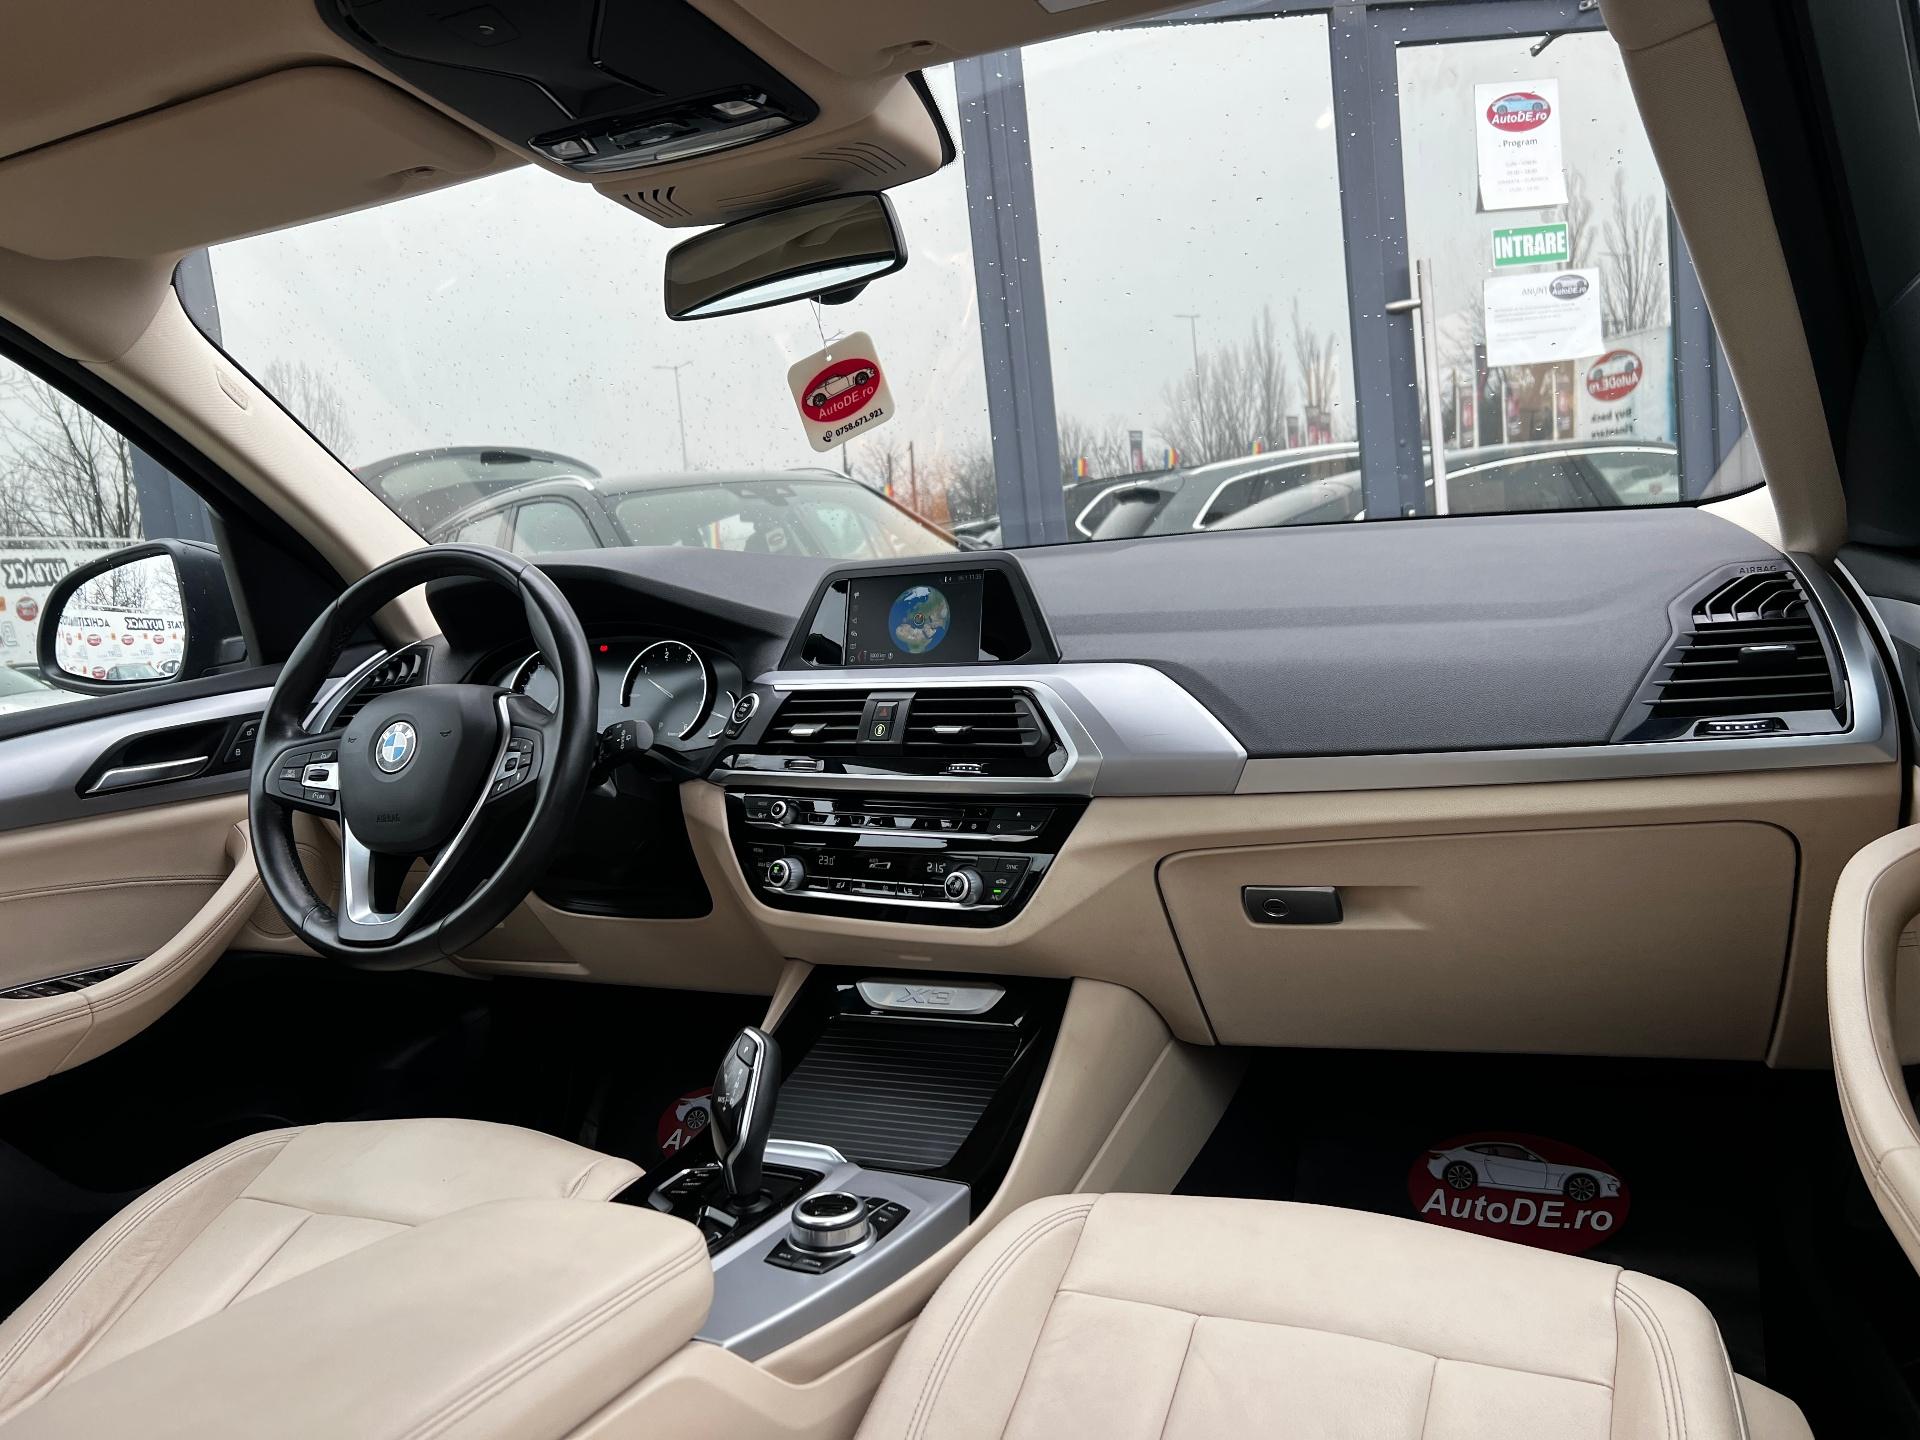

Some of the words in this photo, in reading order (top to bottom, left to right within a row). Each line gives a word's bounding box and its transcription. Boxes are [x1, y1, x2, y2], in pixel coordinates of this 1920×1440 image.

[1491, 110, 1548, 125] AutoDE.ro
[1502, 137, 1538, 148] Program
[1495, 231, 1566, 258] INTRARE
[819, 386, 874, 419] AutoDE.ro
[835, 408, 884, 437] 0758.671.921
[1739, 565, 1777, 574] AIRBAG
[896, 986, 952, 1005] X3
[1421, 1188, 1614, 1232] AutoDE.ro
